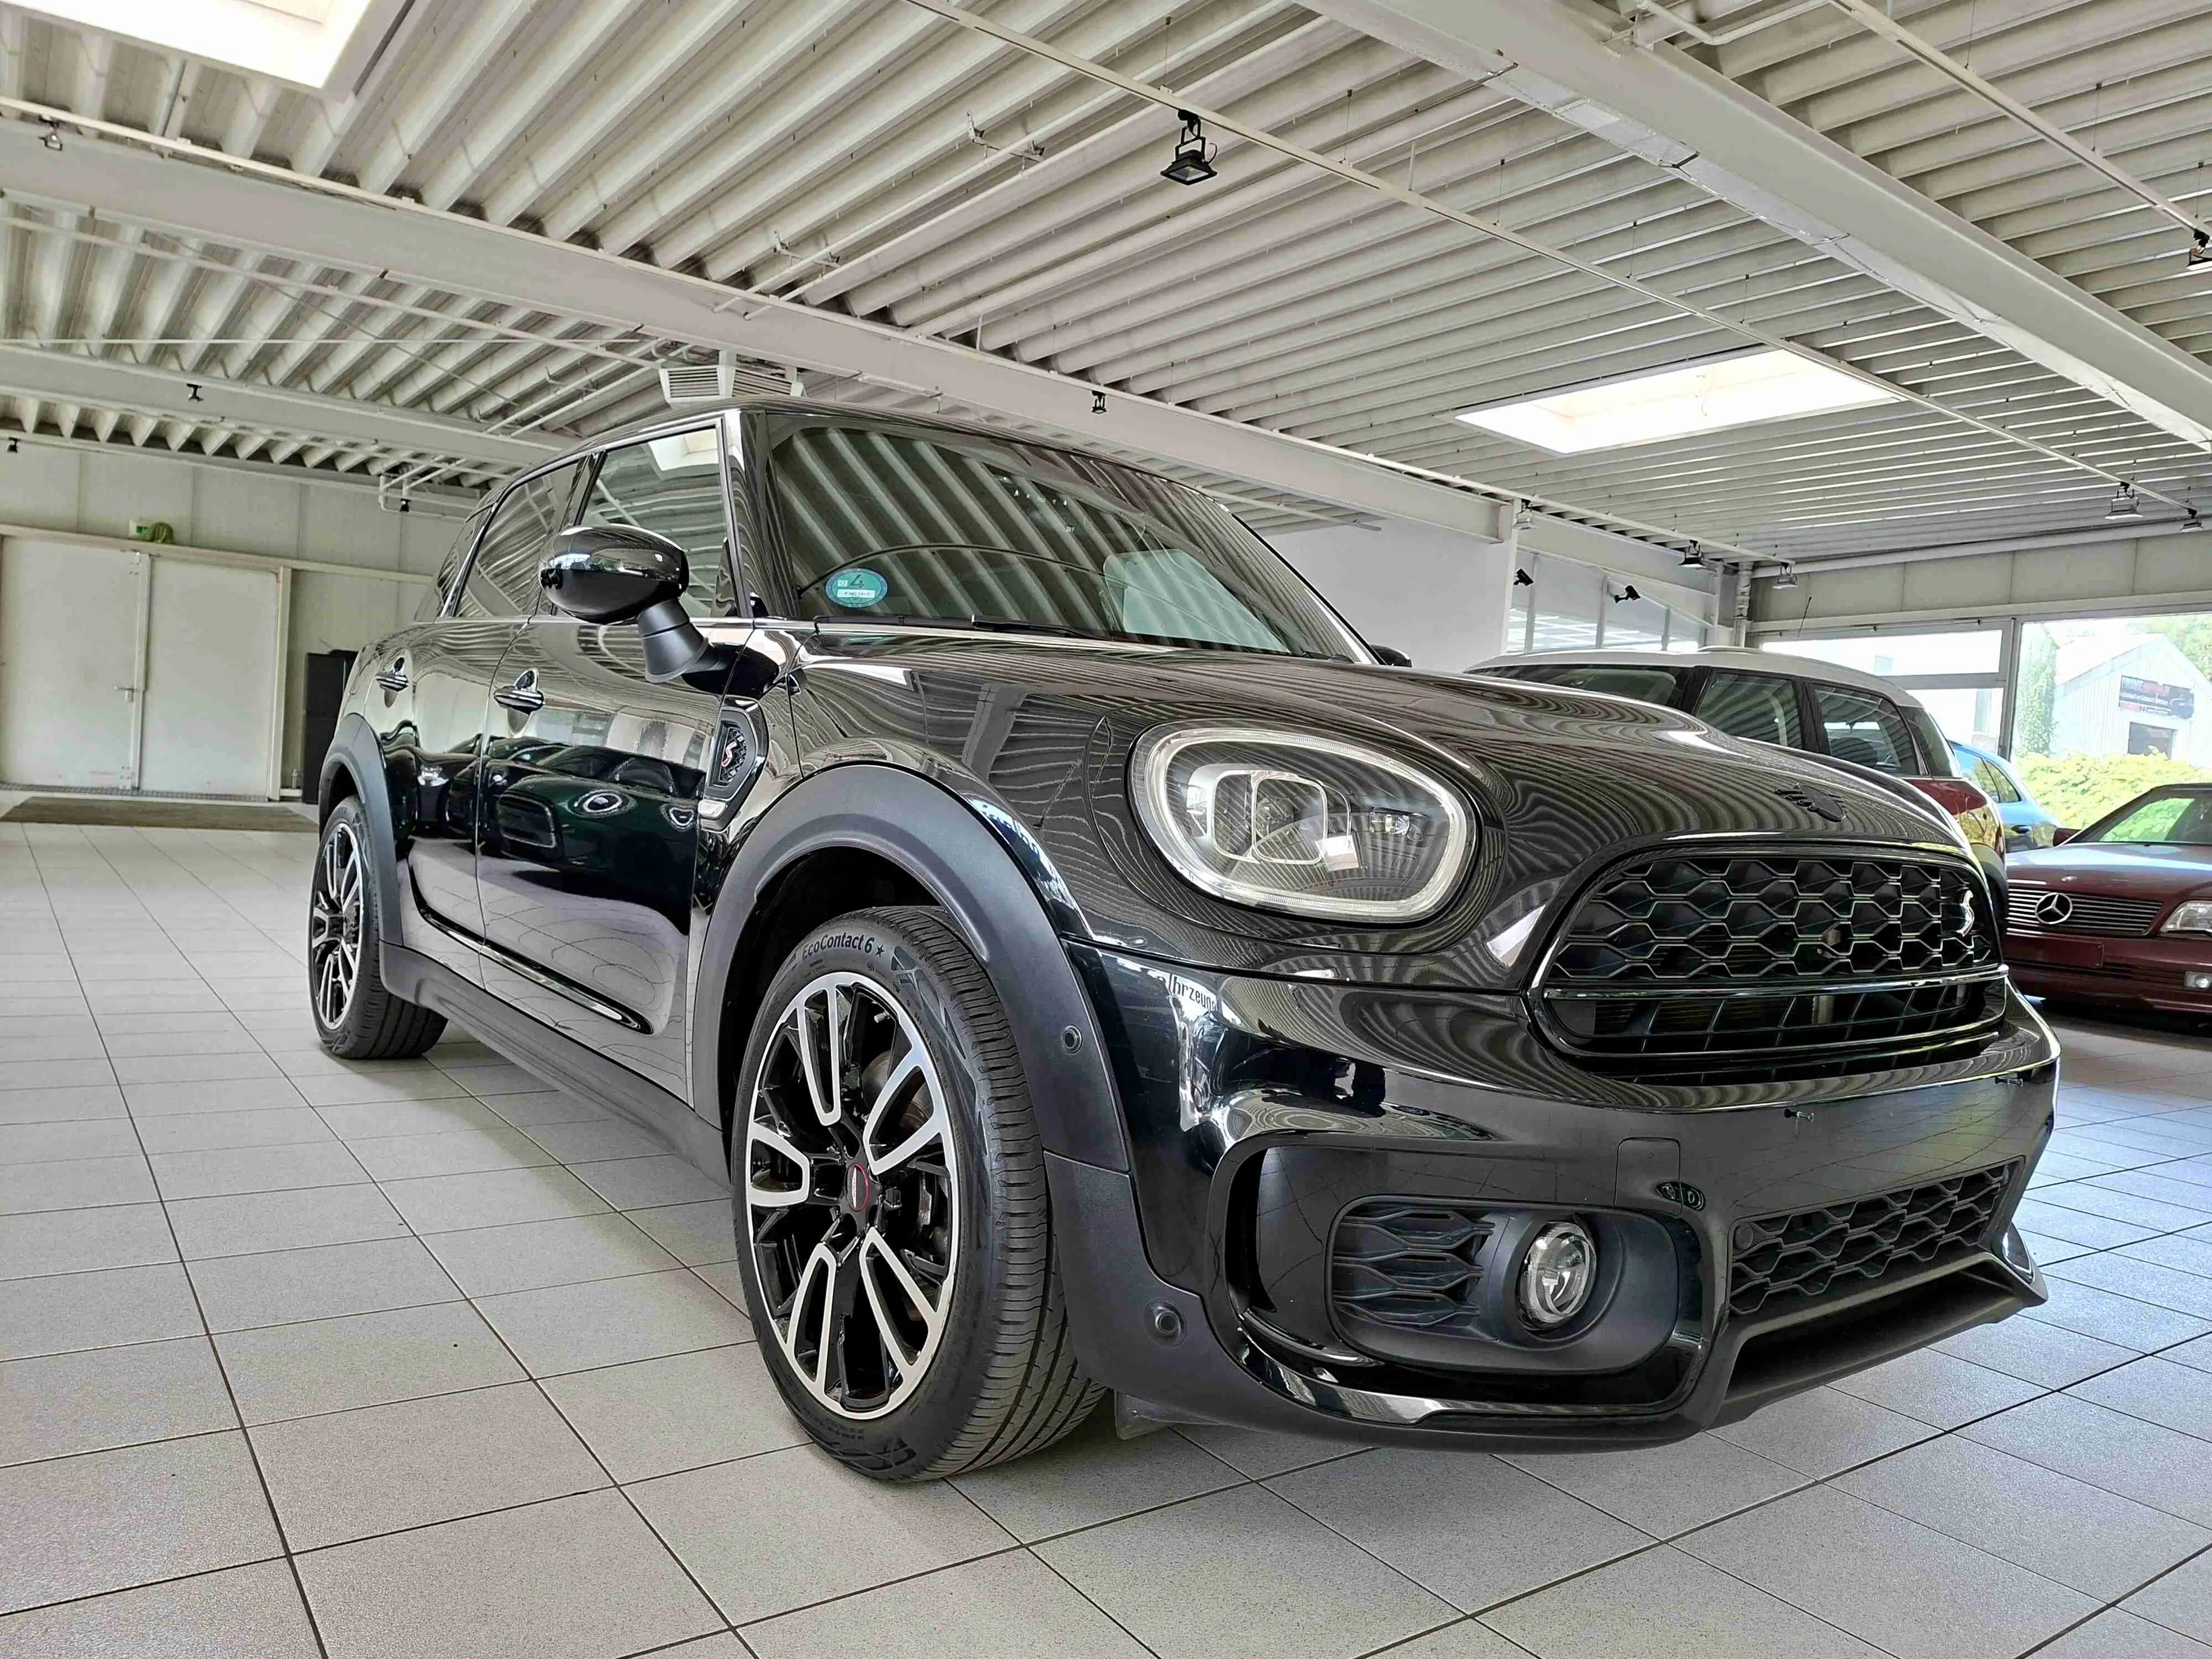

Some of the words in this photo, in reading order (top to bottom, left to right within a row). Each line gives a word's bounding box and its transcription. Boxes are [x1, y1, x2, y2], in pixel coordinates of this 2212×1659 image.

[850, 574, 864, 588] 4
[802, 931, 865, 960] EcoContact
[864, 936, 876, 953] 6
